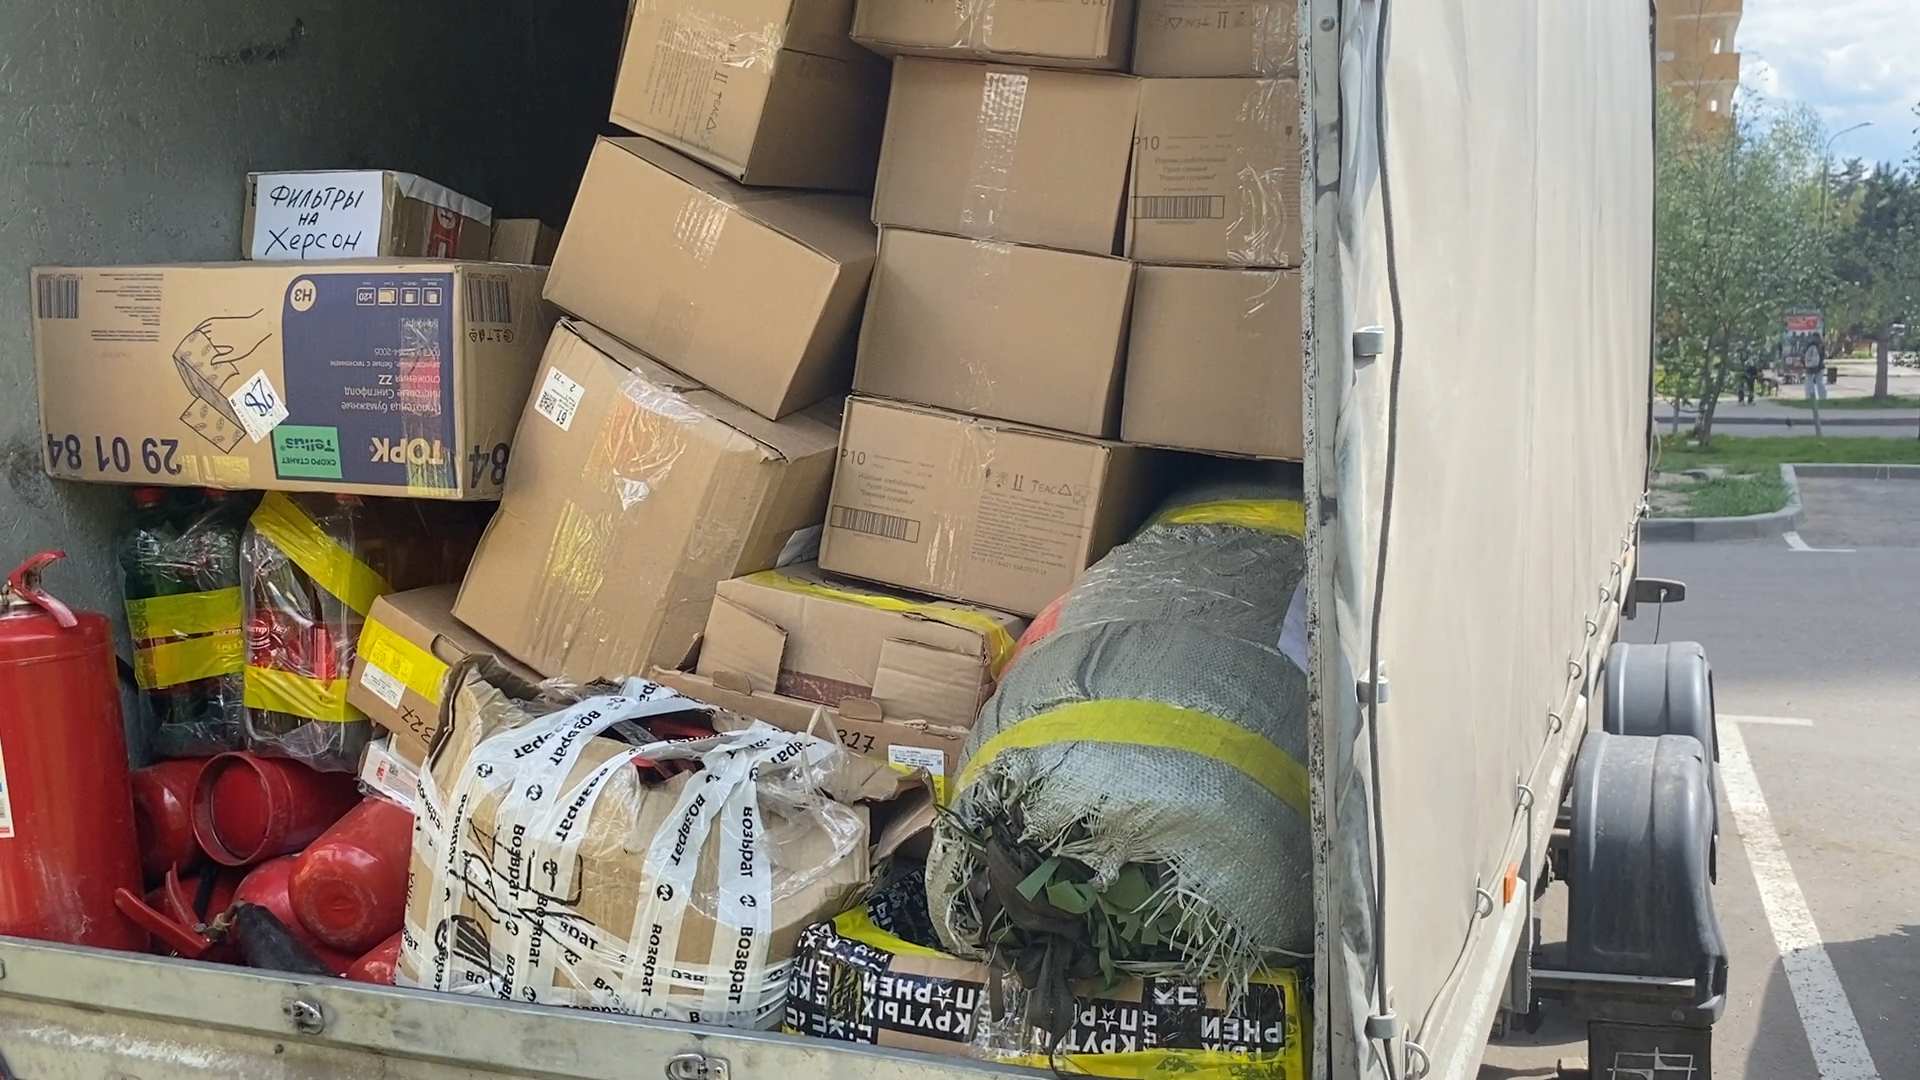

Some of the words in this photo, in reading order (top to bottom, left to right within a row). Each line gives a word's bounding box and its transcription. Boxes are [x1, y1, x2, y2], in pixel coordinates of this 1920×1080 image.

[269, 185, 364, 211] ФИЛЬТРЫ
[298, 212, 320, 226] НА
[377, 374, 393, 385] ZZ
[394, 373, 441, 384] сложения
[343, 386, 394, 399] Синглфолд
[396, 388, 441, 398] листовые
[340, 400, 388, 414] бумажные
[390, 402, 441, 415] Полотенца
[284, 437, 335, 452] Tellus
[371, 436, 444, 466] ТОРК
[47, 433, 82, 471] 84
[95, 436, 131, 473] 01
[141, 437, 182, 475] 29
[281, 456, 309, 466] СТАНЕТ
[309, 457, 337, 467] СКОРО
[862, 996, 972, 1037] КРУТЫХ
